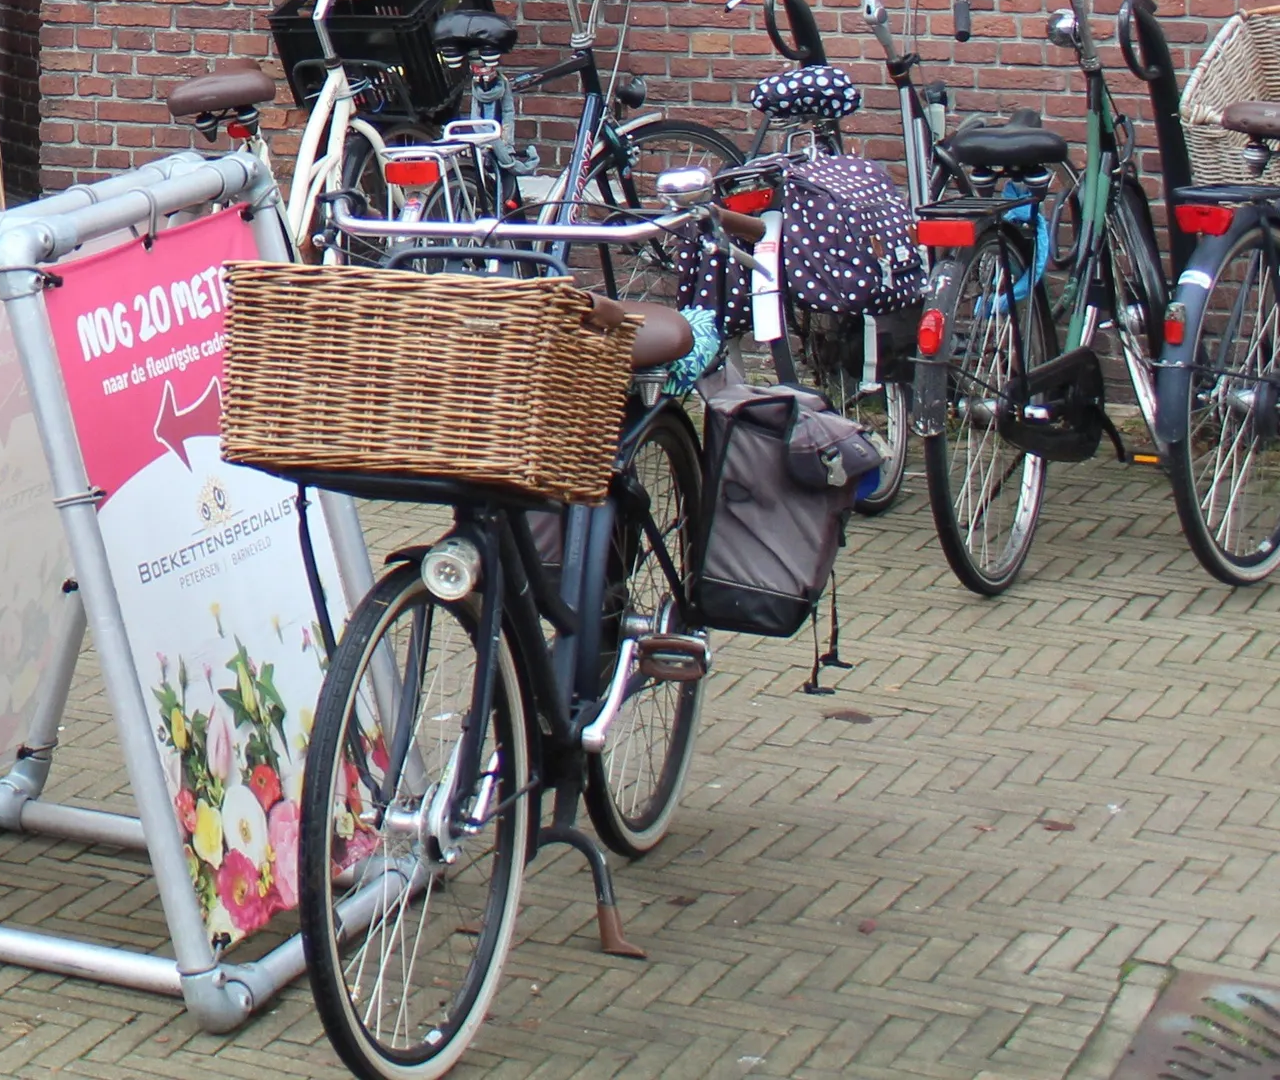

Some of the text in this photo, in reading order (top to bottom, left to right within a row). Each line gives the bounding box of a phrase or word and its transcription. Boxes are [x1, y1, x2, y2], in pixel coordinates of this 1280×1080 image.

[77, 302, 133, 362] NOG
[134, 285, 171, 342] 20
[102, 372, 129, 396] naar
[131, 364, 147, 385] de
[146, 344, 200, 380] fleurigste
[179, 536, 272, 589] PETERSEN BARNEVELD
